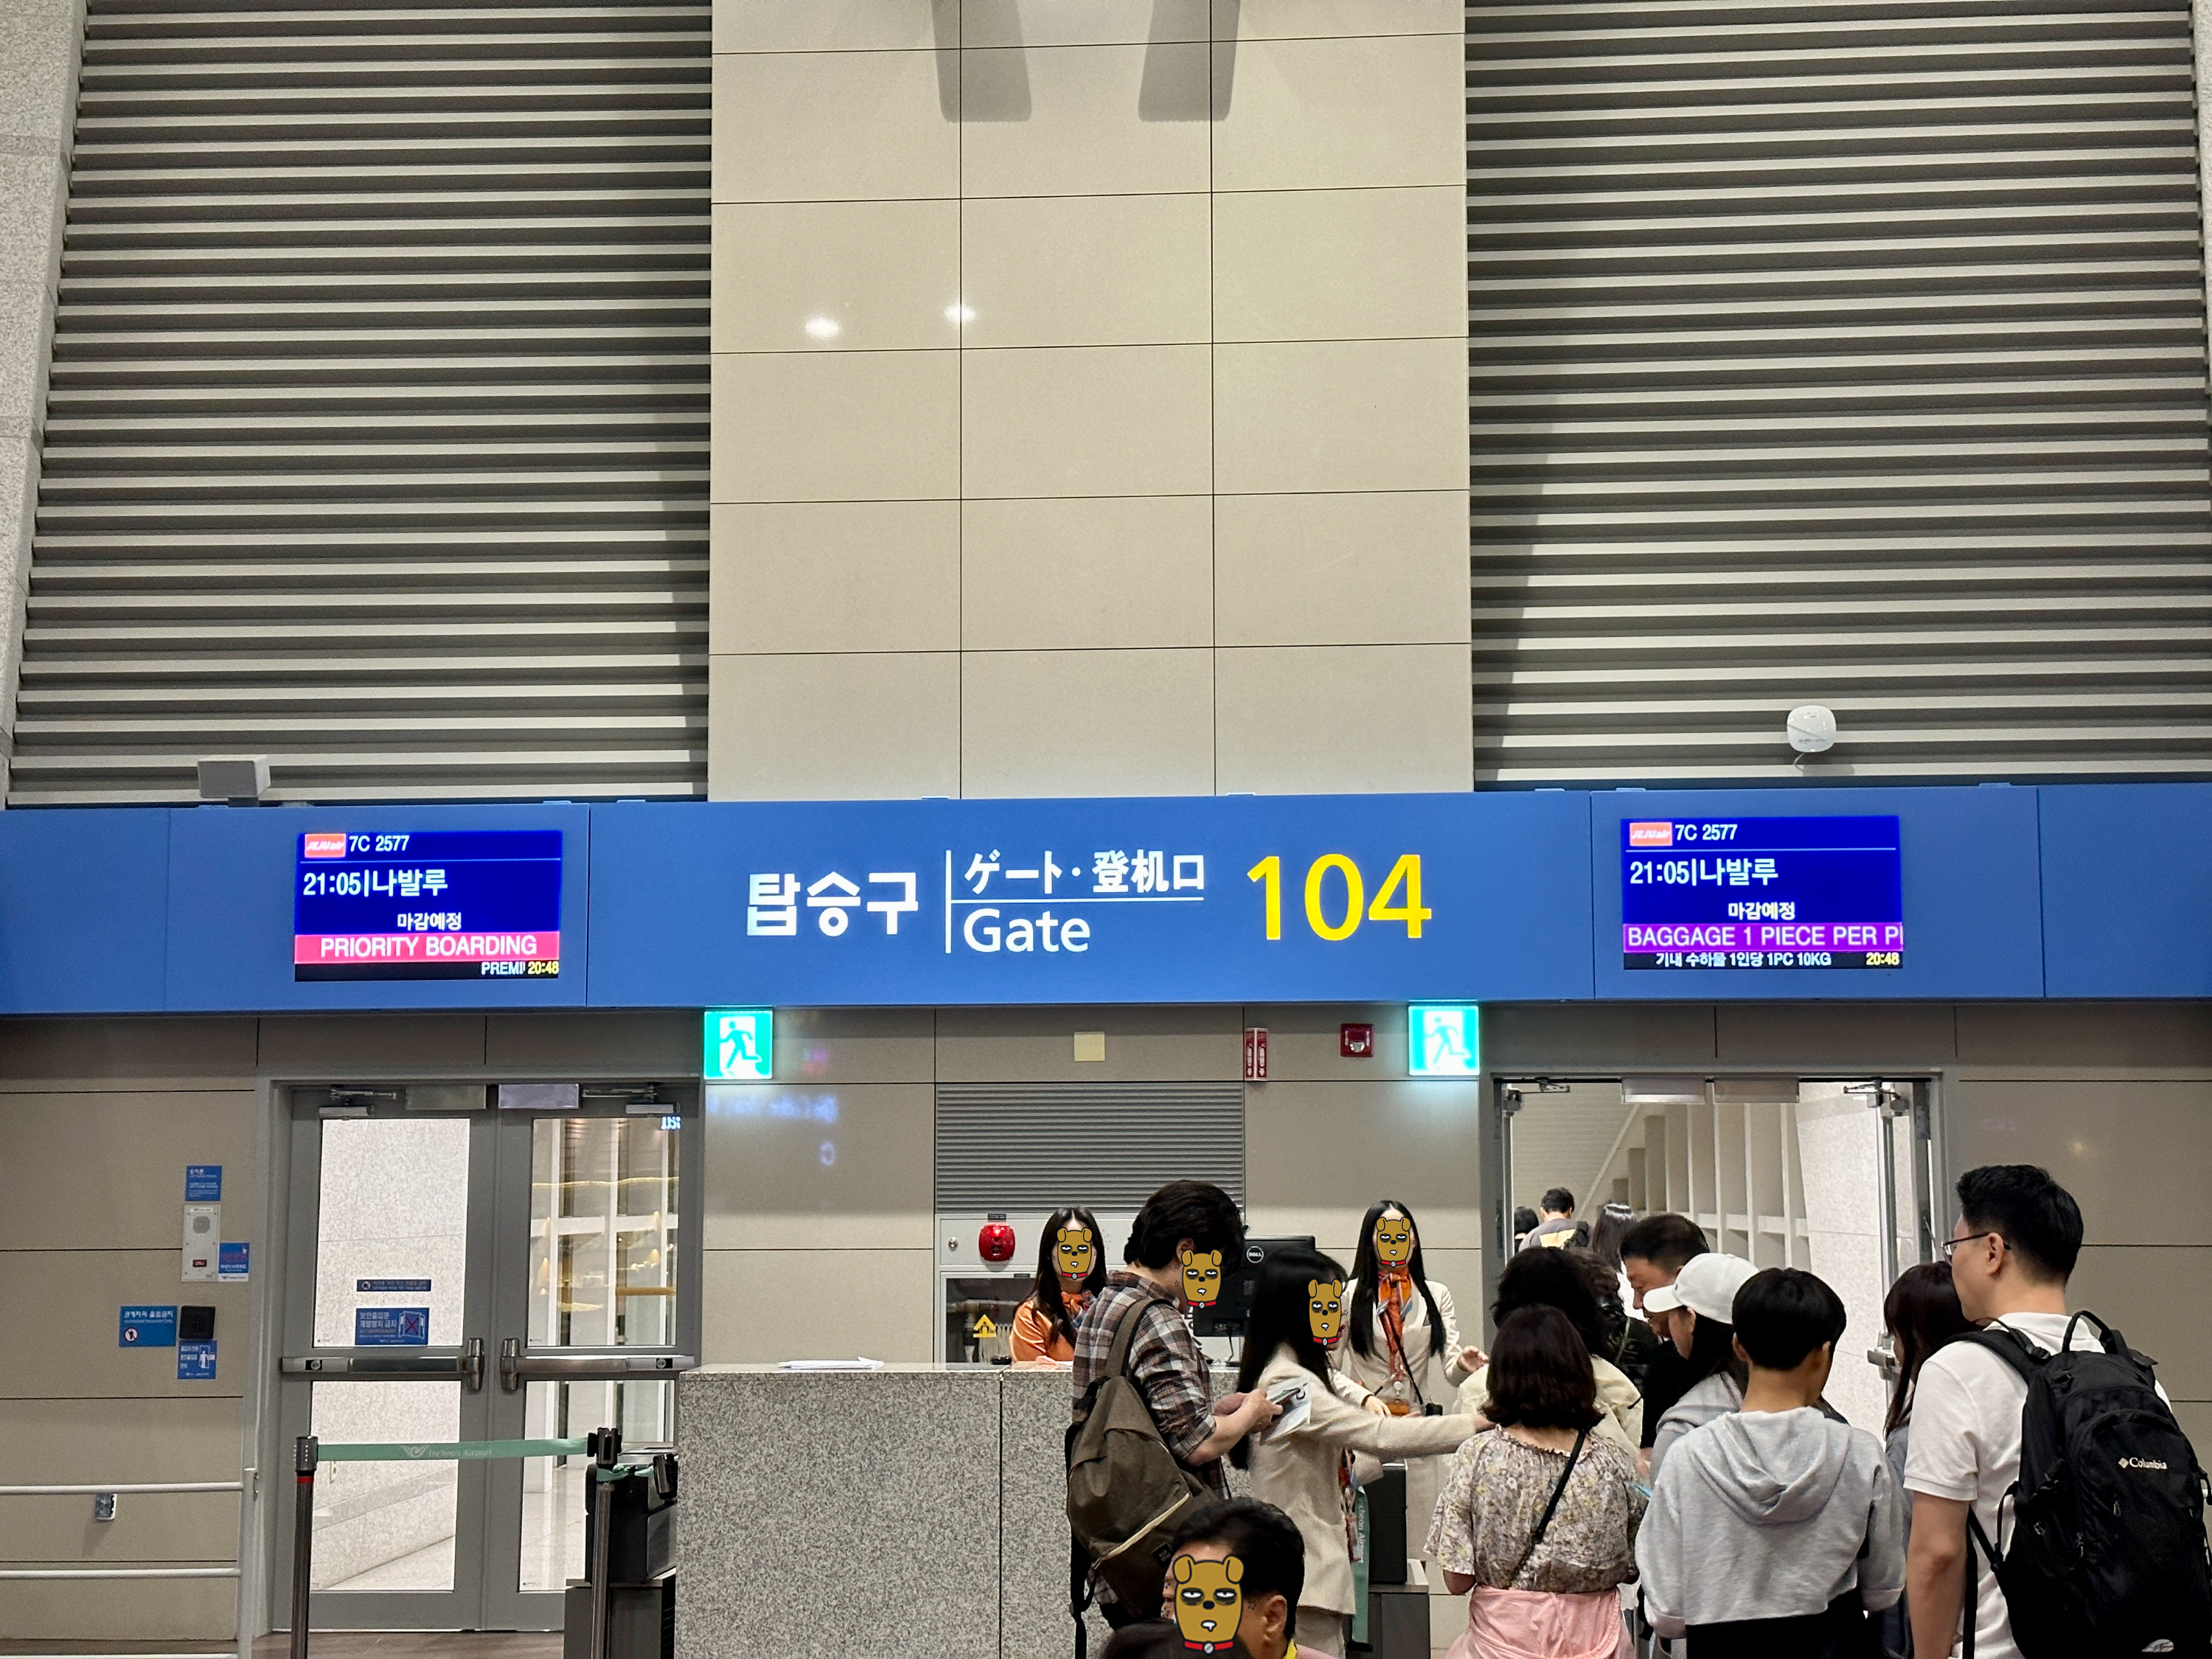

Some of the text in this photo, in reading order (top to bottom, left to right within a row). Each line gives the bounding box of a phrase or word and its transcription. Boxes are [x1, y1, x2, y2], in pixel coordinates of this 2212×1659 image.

[1674, 824, 1697, 841] 7C
[1702, 824, 1738, 841] 2577
[349, 835, 370, 852] 7C
[375, 835, 410, 852] 2577
[746, 871, 919, 937] 탑승구
[1248, 853, 1431, 941] 104
[1728, 901, 1796, 921] 마감예정
[397, 912, 462, 931] 마감예정
[963, 908, 1091, 953] Gate
[1628, 925, 1904, 946] BAGGAGE 1 PIECE PER P
[321, 934, 538, 958] PRIORITY BOARDING
[481, 961, 526, 975] PREMI
[527, 961, 560, 975] 20:48
[1655, 952, 1832, 967] 기내 수하물 1인당 1PC 10KG
[1865, 953, 1900, 966] 20:48
[2128, 1457, 2168, 1470] Columbia
